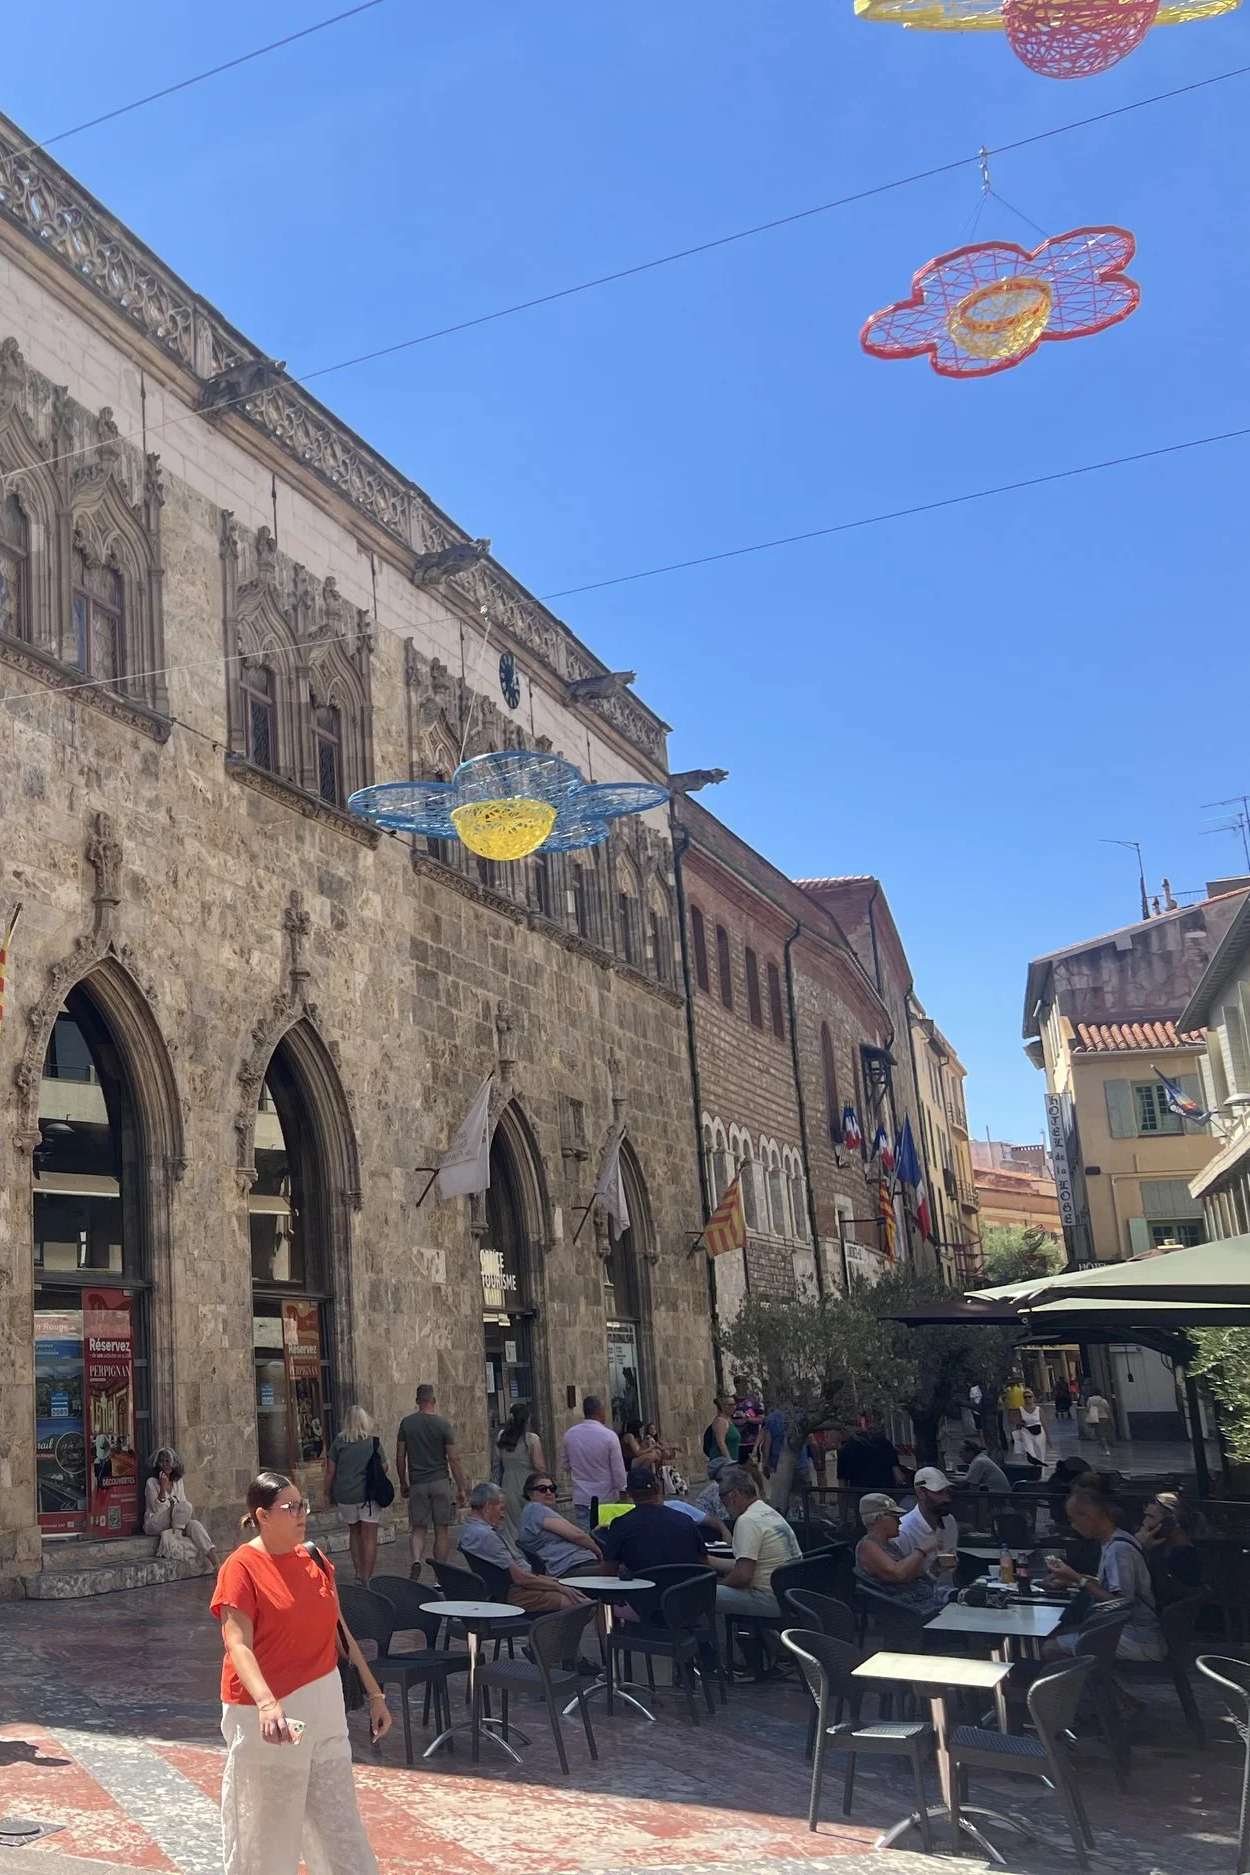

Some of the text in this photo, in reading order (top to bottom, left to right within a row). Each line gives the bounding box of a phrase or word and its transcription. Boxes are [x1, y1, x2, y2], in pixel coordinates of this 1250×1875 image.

[1079, 1261, 1107, 1271] HÔT
[481, 1271, 517, 1291] TOURISME
[89, 1337, 130, 1352] Réservez
[89, 1365, 130, 1377] PERPIGNAN
